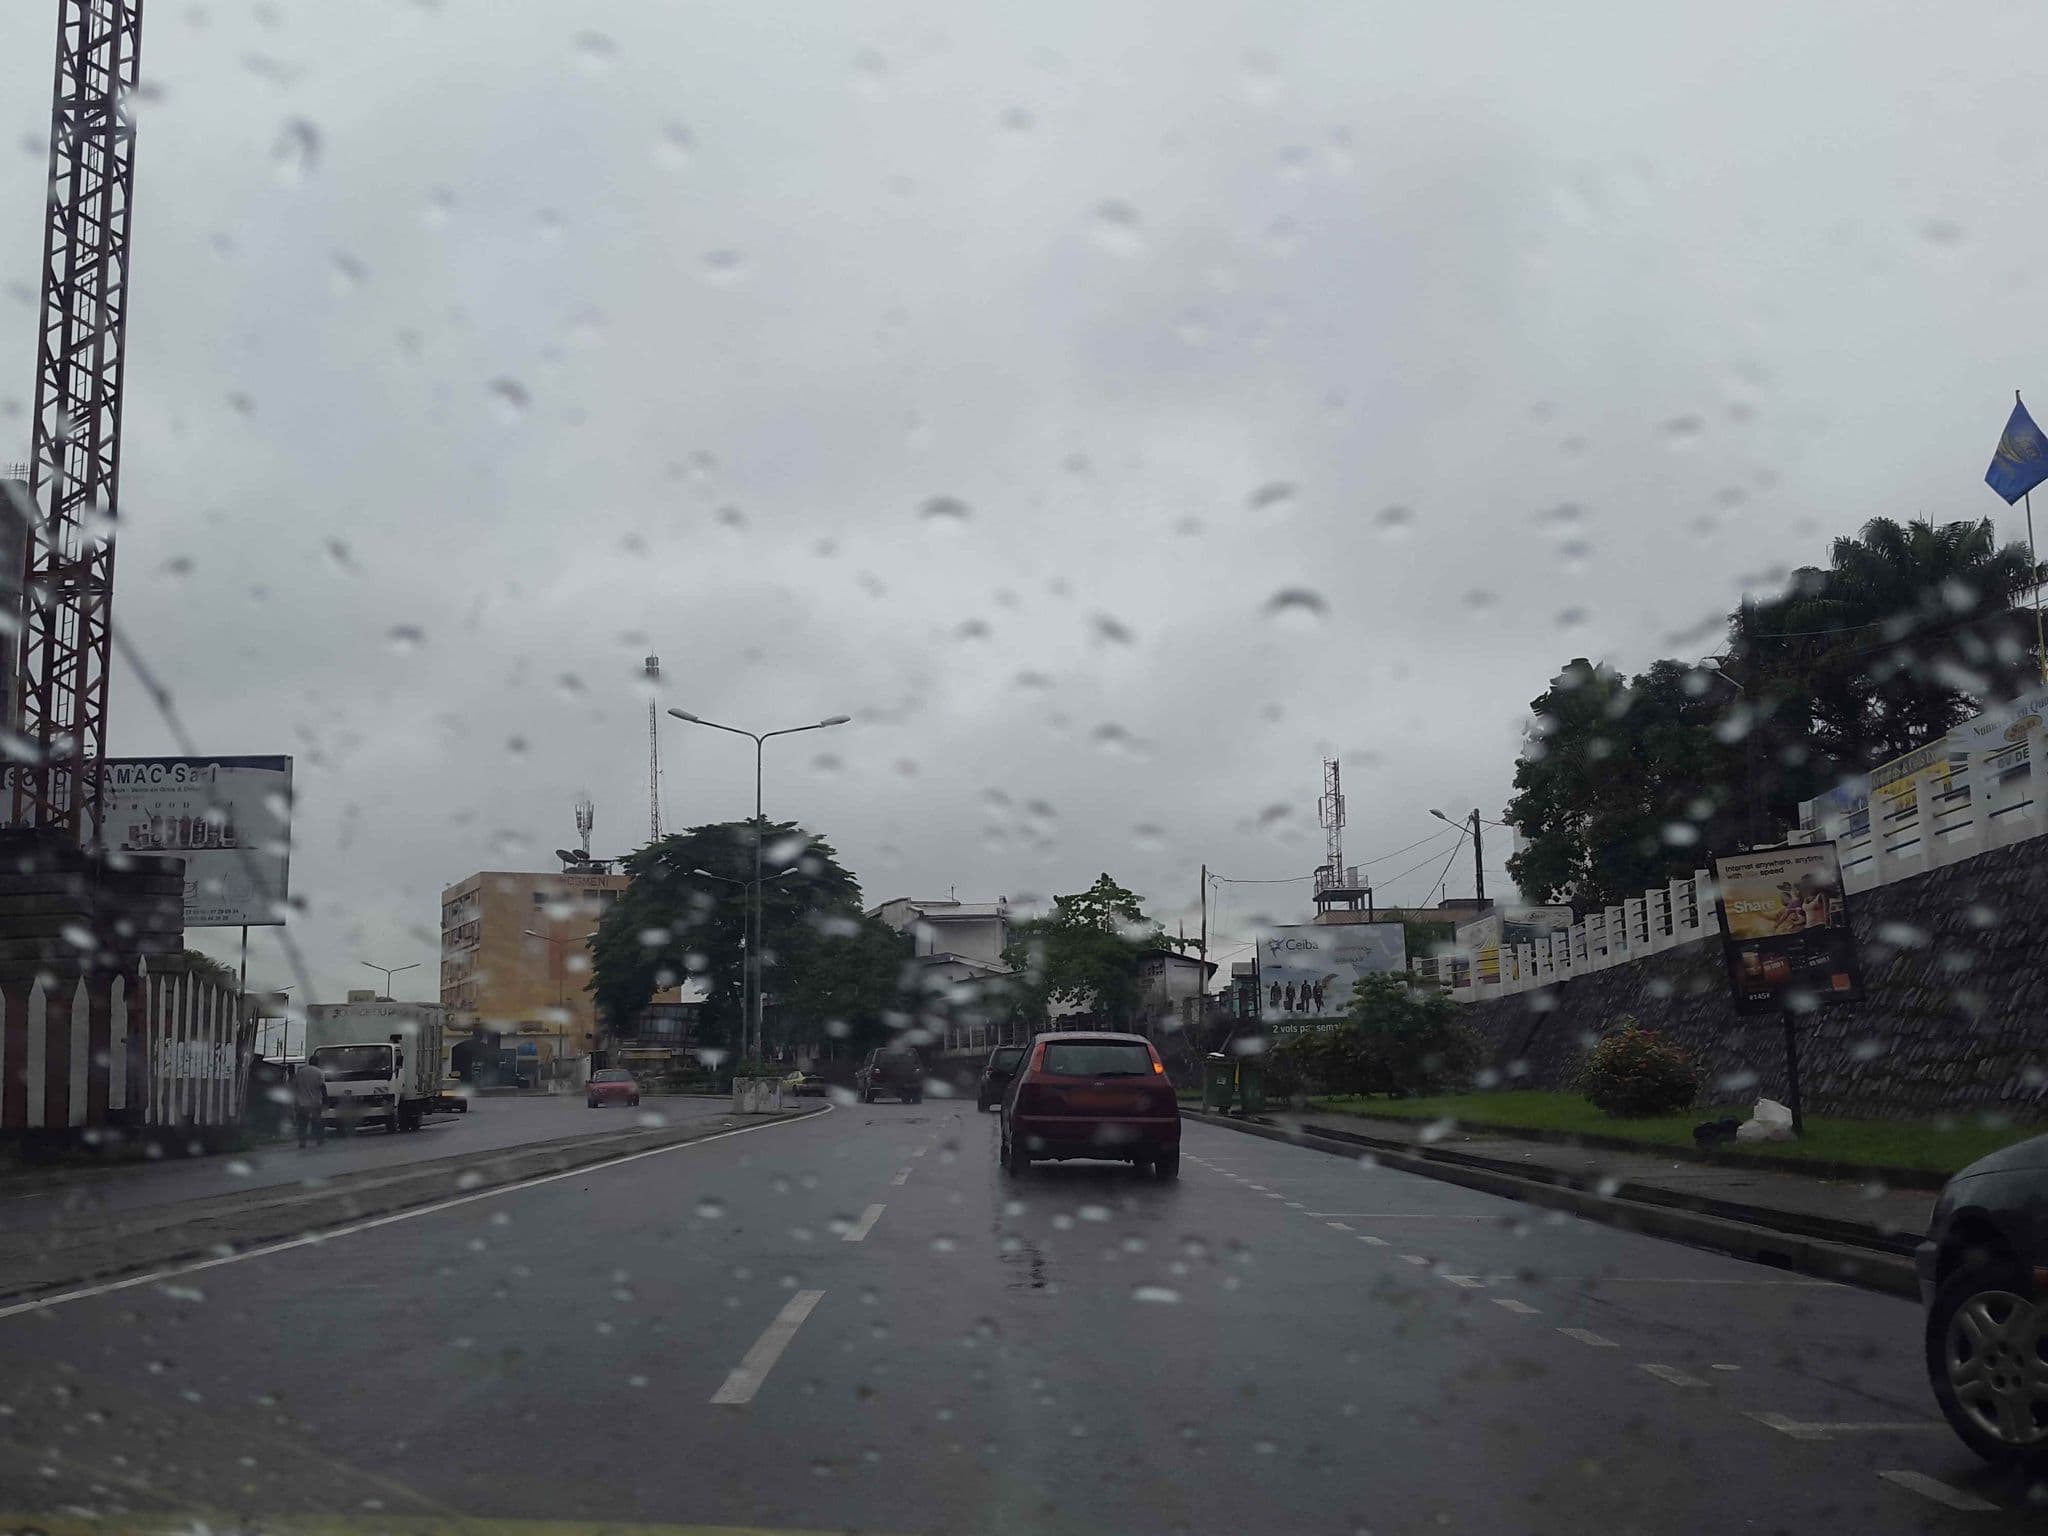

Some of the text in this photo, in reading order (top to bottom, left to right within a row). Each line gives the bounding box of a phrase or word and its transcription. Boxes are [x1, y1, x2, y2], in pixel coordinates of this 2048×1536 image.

[1725, 863, 1754, 873] Internet
[1760, 867, 1784, 878] speed
[1733, 900, 1777, 914] Share
[1286, 939, 1319, 950] Ceiba
[1272, 1025, 1279, 1034] 2
[1280, 1024, 1298, 1033] vols
